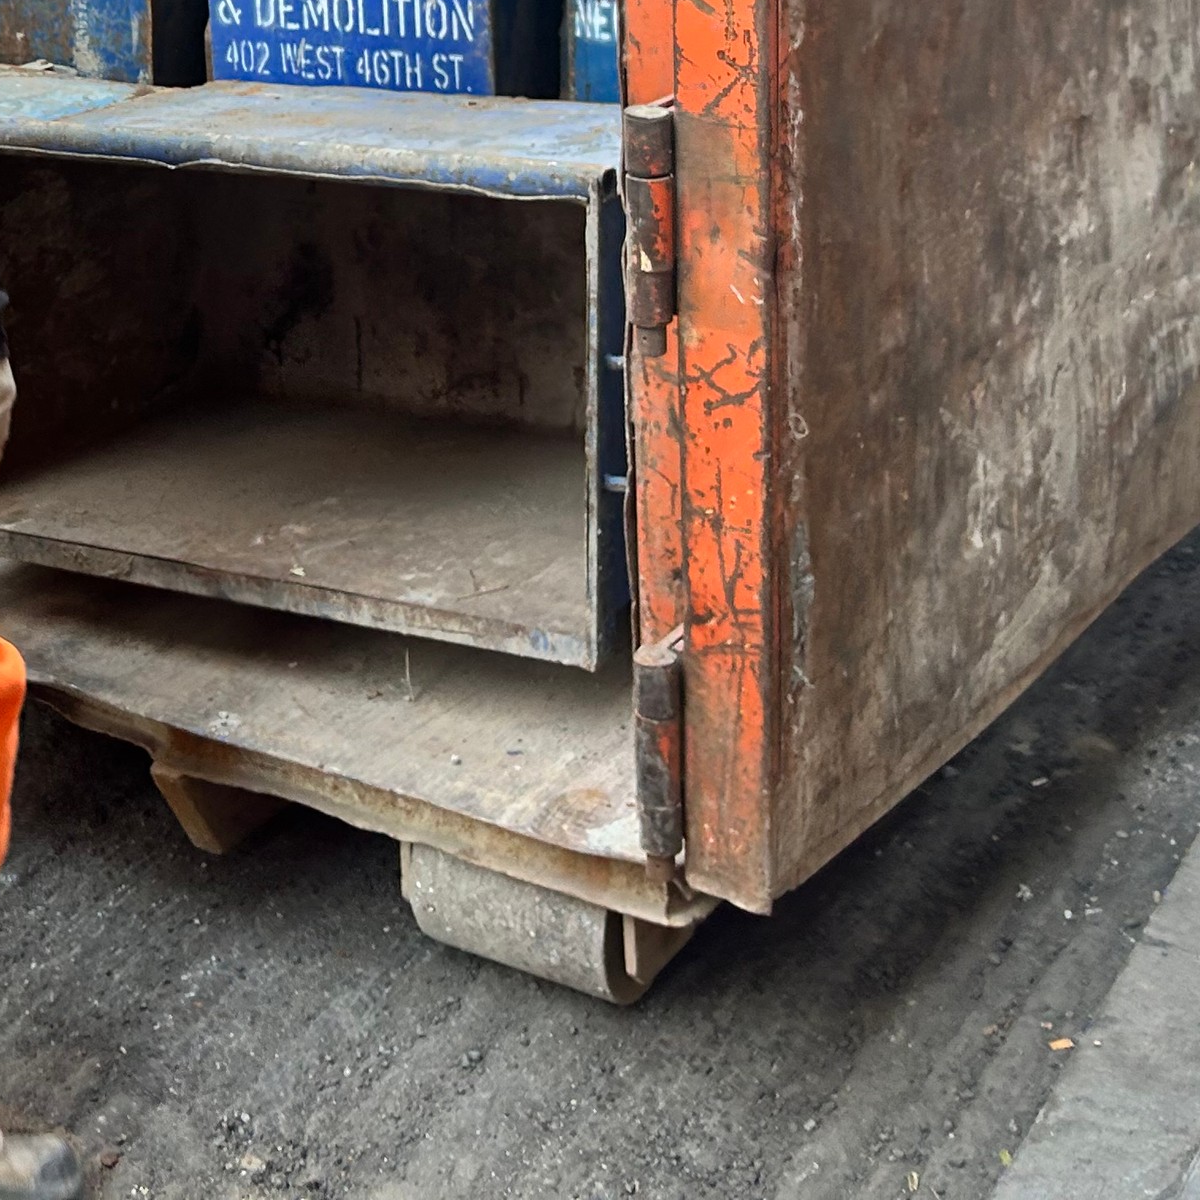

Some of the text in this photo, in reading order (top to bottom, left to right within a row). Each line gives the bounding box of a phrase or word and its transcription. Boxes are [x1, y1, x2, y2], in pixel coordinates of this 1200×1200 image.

[225, 38, 271, 75] 402
[281, 40, 345, 81] WEST
[356, 48, 423, 89] 46TH
